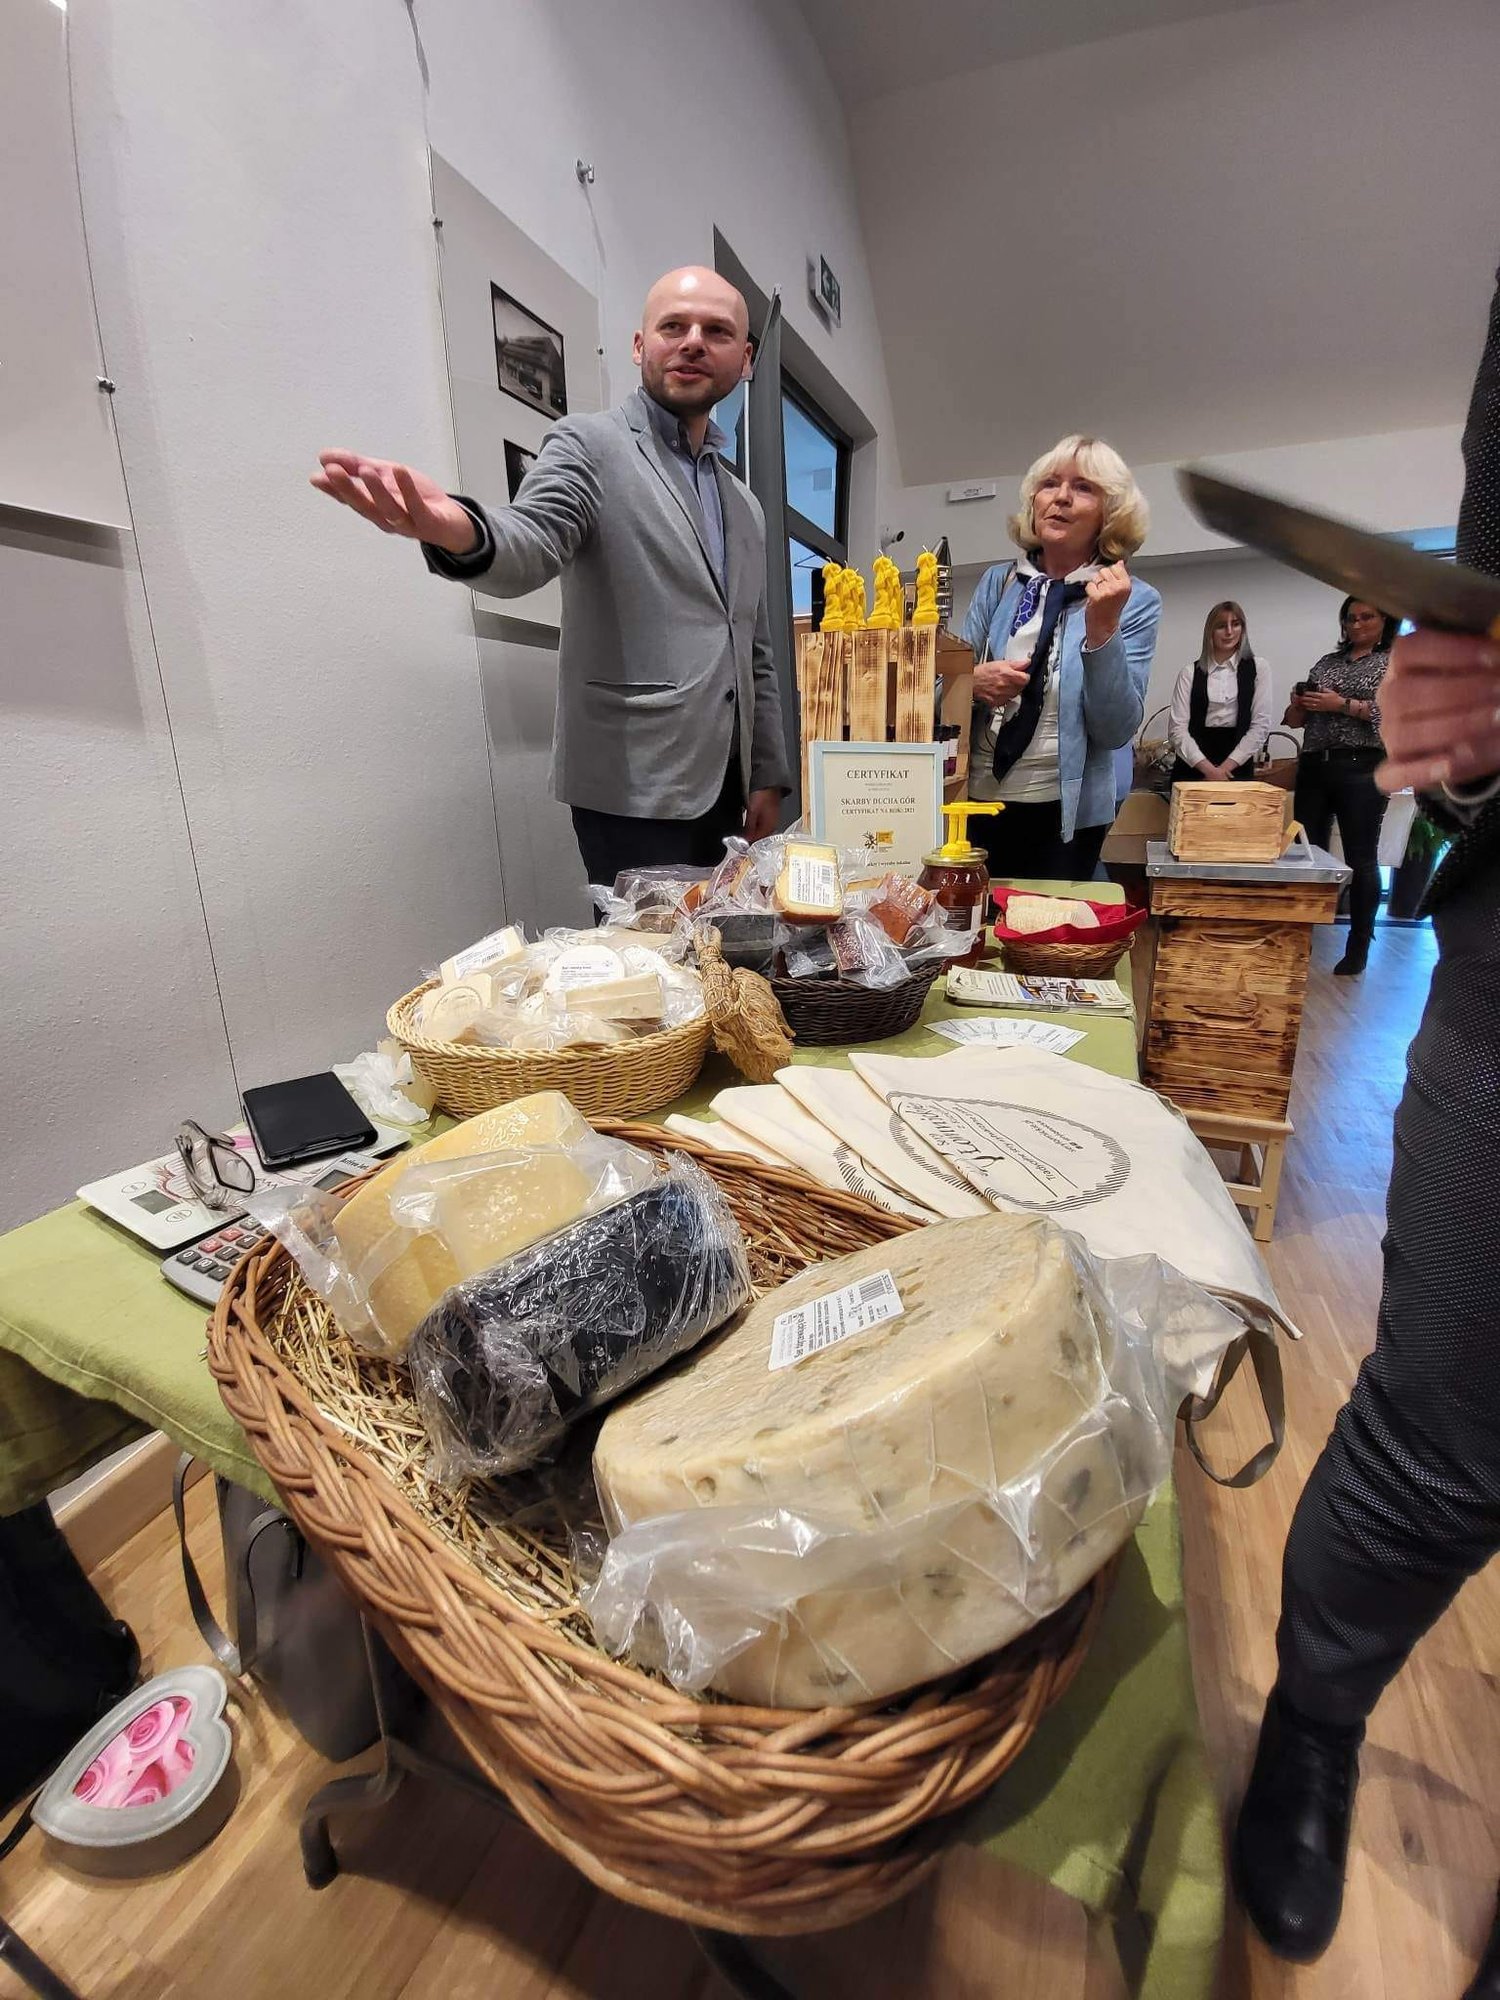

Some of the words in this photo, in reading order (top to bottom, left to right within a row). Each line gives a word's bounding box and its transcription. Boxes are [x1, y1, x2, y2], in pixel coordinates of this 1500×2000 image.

[846, 769, 910, 779] CERTYFIKAT
[840, 798, 871, 806] SKARBY
[899, 796, 916, 805] GÓR
